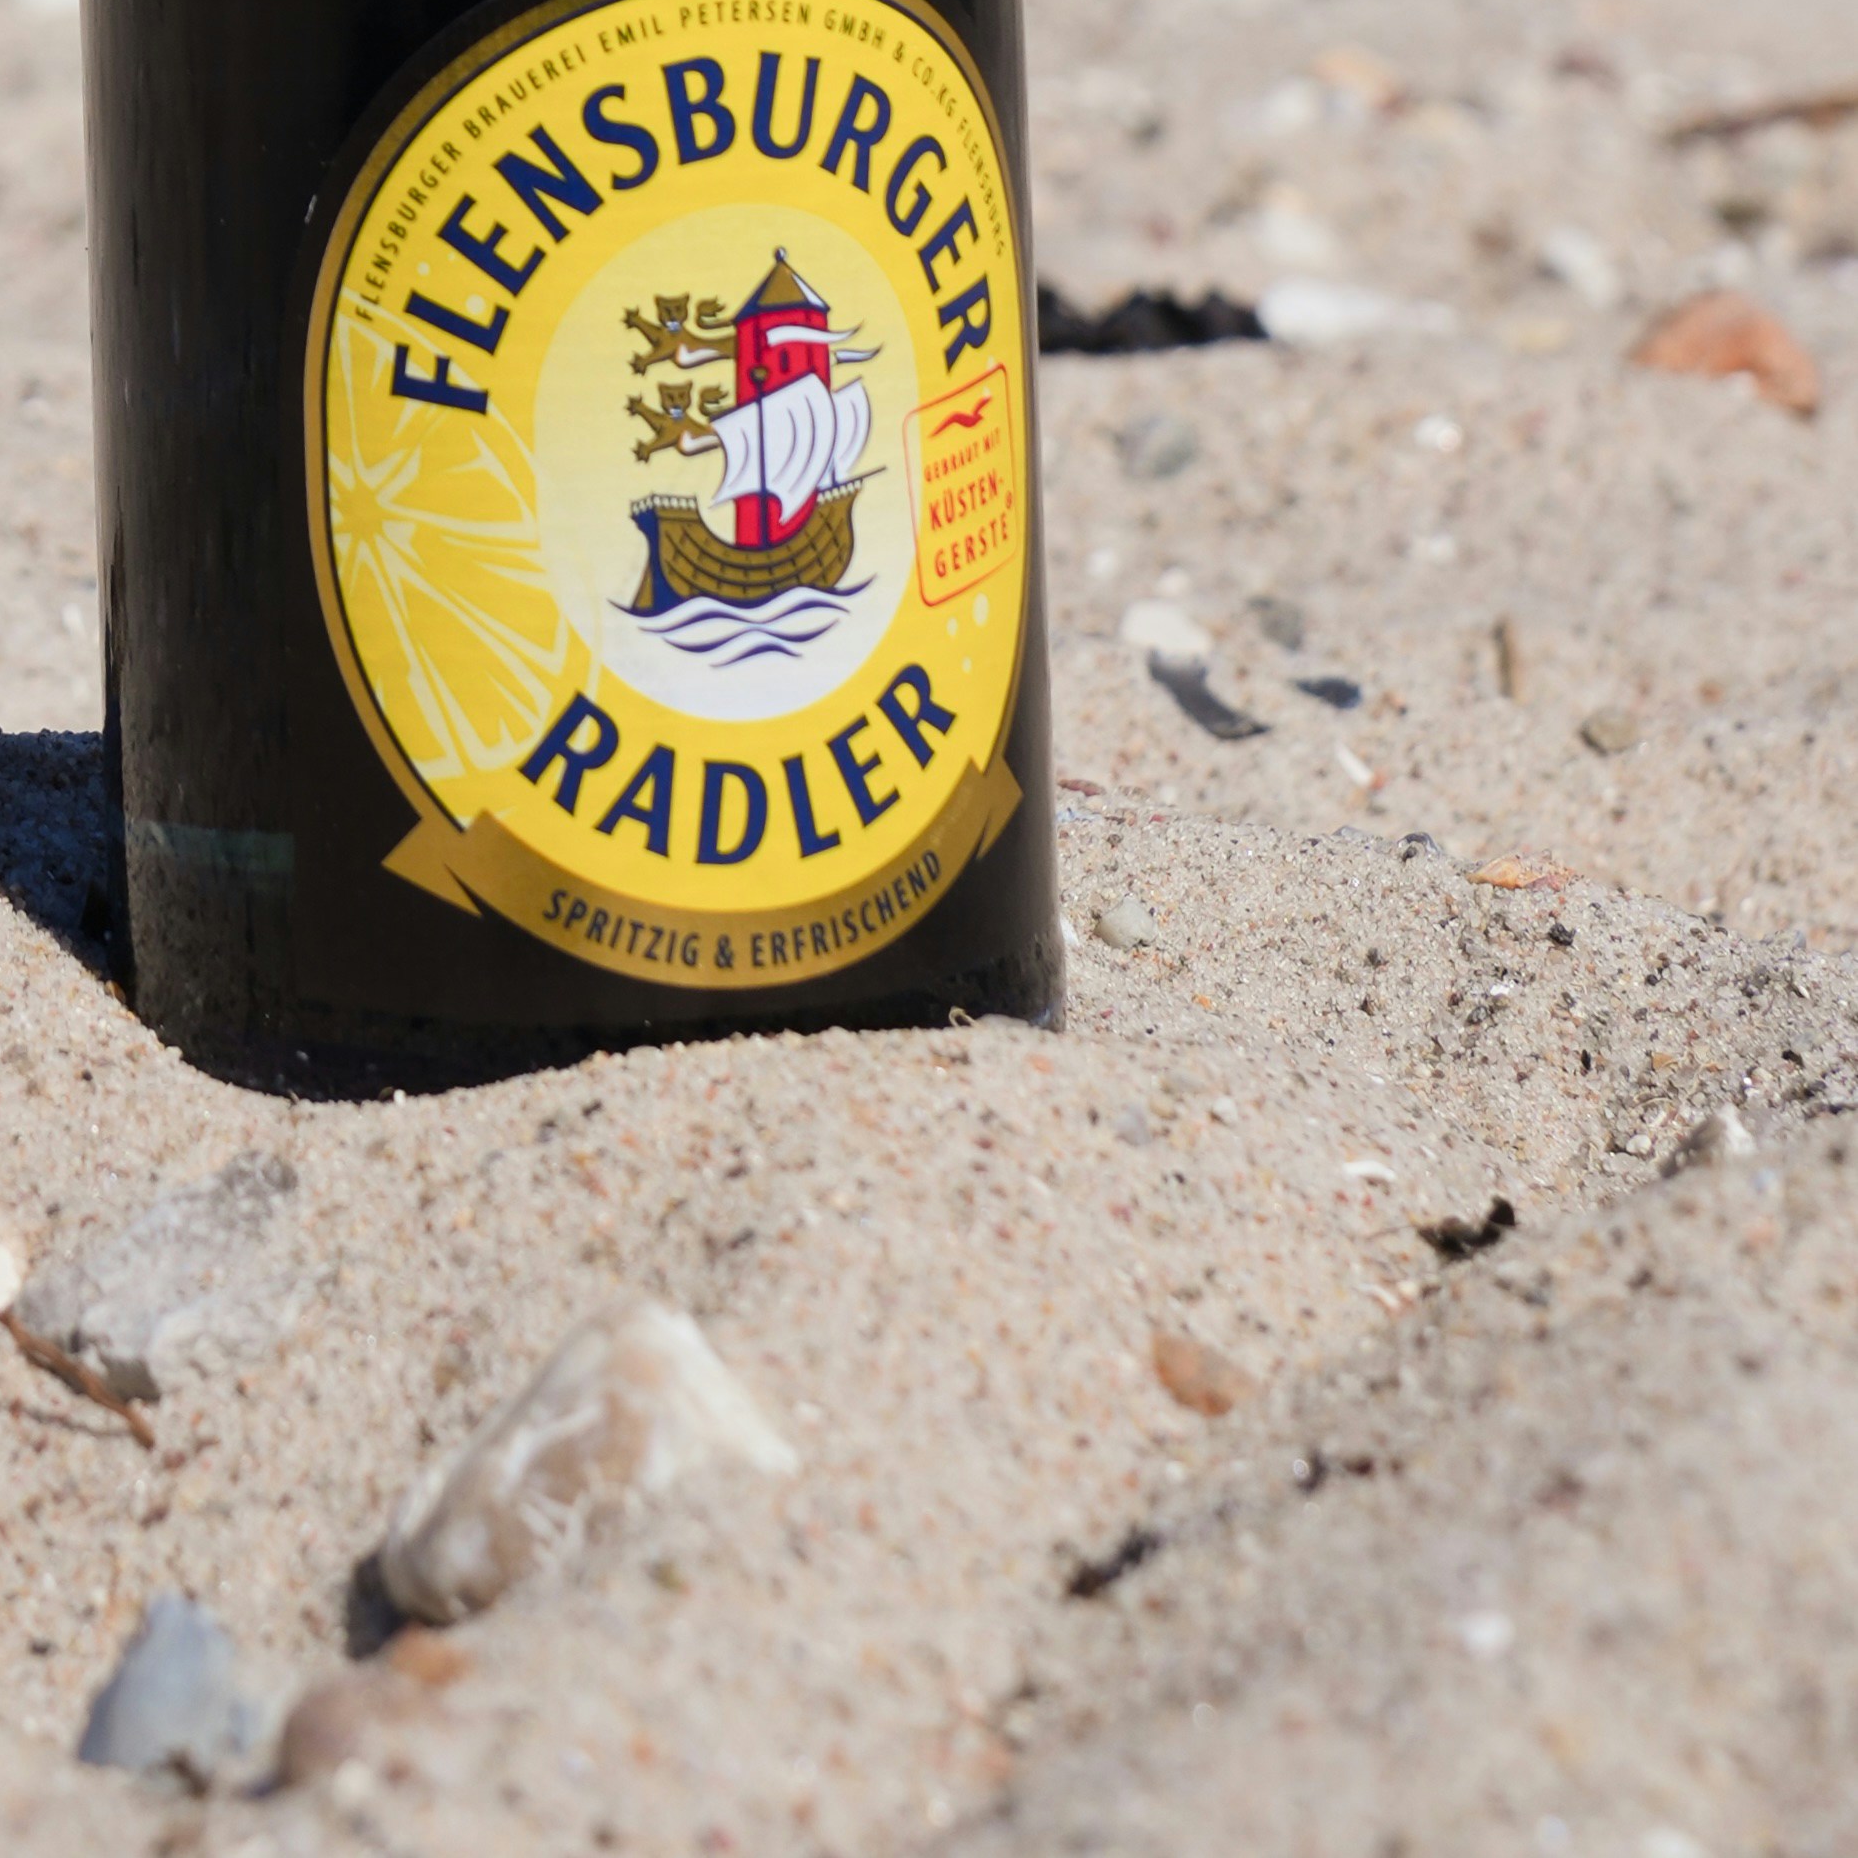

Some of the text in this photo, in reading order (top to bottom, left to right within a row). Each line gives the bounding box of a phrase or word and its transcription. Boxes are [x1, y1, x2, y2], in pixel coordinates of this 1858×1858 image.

[355, 140, 462, 324] FLENSBURGER
[463, 43, 588, 139] BRAUEREI
[598, 14, 665, 54] EMIL
[679, 0, 812, 28] PETERSEN
[824, 8, 886, 50] GMBH
[892, 40, 905, 63] &
[956, 117, 1006, 259] FLENSBURG
[390, 50, 993, 416] FLENSBURGER
[923, 427, 1002, 484] GEBRAUT MIT
[928, 468, 1004, 532] KÜSTEN-
[517, 662, 957, 865] RADLER
[543, 849, 942, 969] SPRITZIG & ERFRISCHEND
